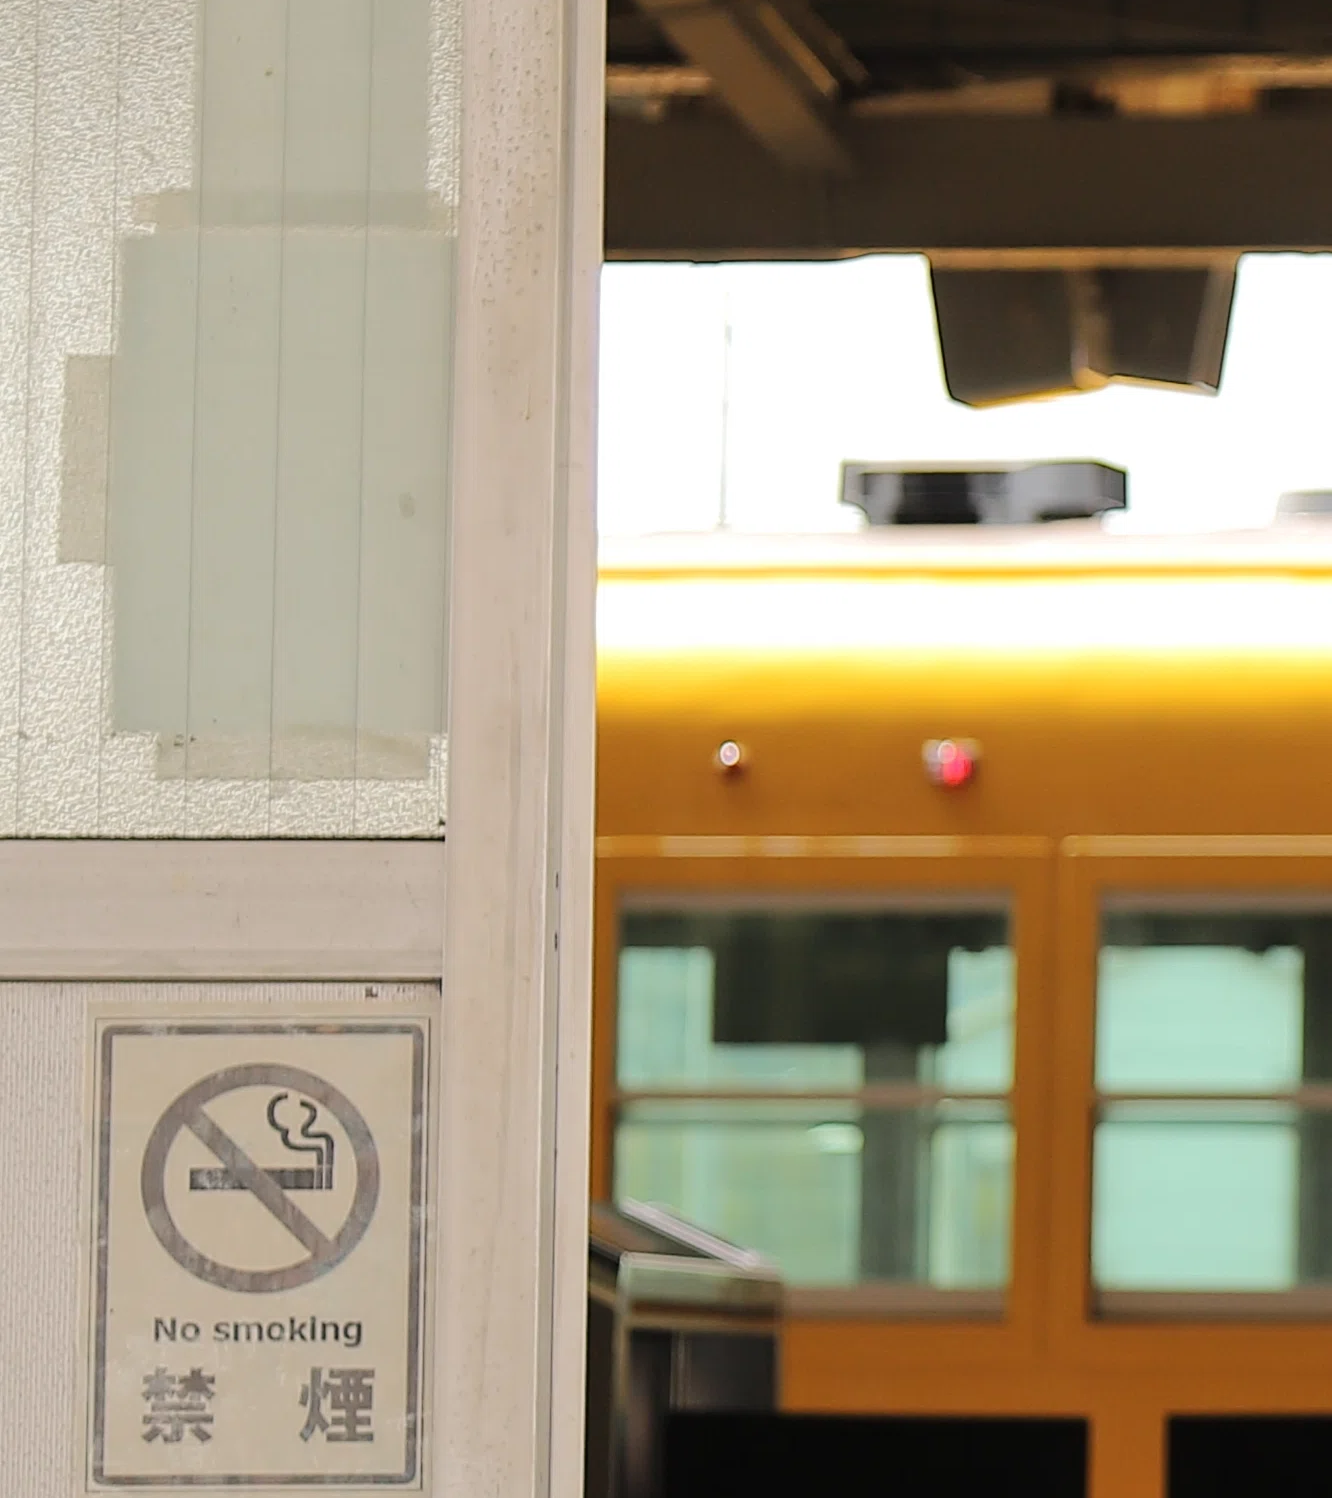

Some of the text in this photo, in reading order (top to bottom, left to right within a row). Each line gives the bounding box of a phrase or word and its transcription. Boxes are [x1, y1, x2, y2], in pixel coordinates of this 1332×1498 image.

[154, 1317, 362, 1347] No smoking
[141, 1366, 375, 1444] 禁煙
